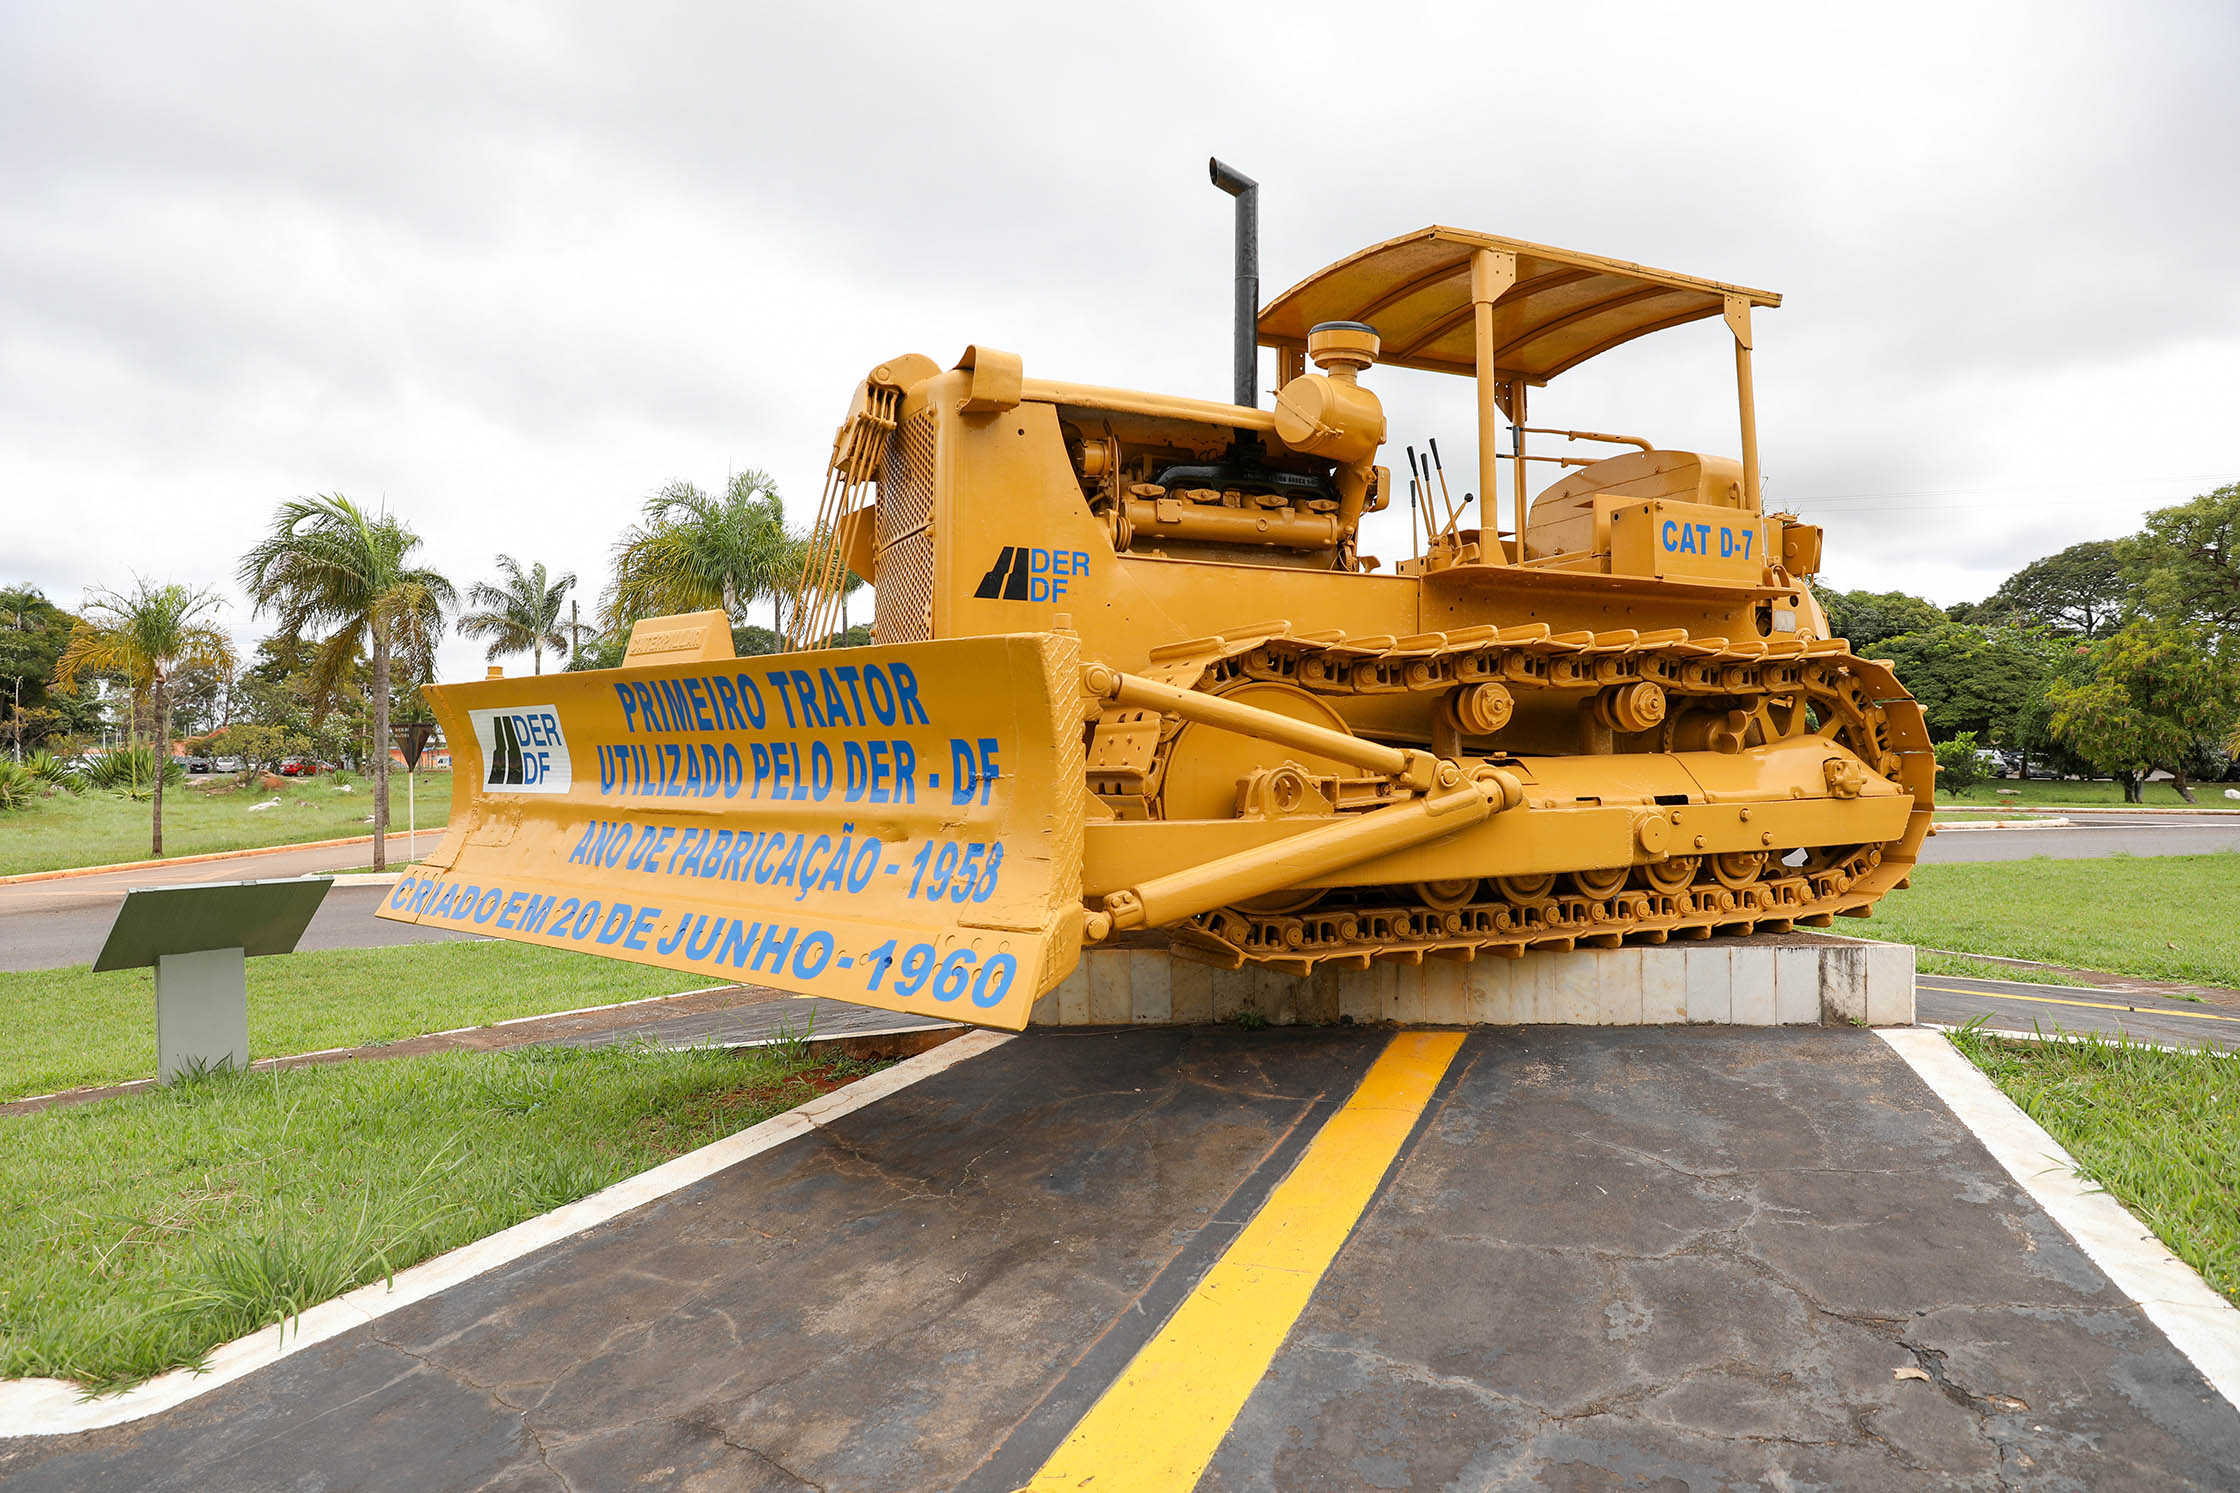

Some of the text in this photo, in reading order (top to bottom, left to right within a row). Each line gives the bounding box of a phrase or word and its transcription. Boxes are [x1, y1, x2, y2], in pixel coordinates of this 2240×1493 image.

[1662, 520, 1753, 561] CAT D-7
[1031, 548, 1090, 577] DER
[1030, 577, 1068, 603] DF
[614, 662, 930, 733] PRIMEIRO TRATOR
[511, 713, 562, 747] DER
[522, 752, 551, 785] DF
[597, 742, 743, 799] UTILIZADO
[750, 741, 833, 802] PELO
[843, 740, 916, 804] DER
[950, 737, 1000, 806] DF
[568, 820, 633, 866] ANO
[626, 825, 676, 873] DE
[666, 822, 882, 902] FABRICAÇÃO
[908, 840, 1004, 903] 1958
[390, 876, 503, 924] CRIADO
[495, 891, 558, 934] EM
[547, 897, 602, 941] 20
[596, 903, 662, 951] DE
